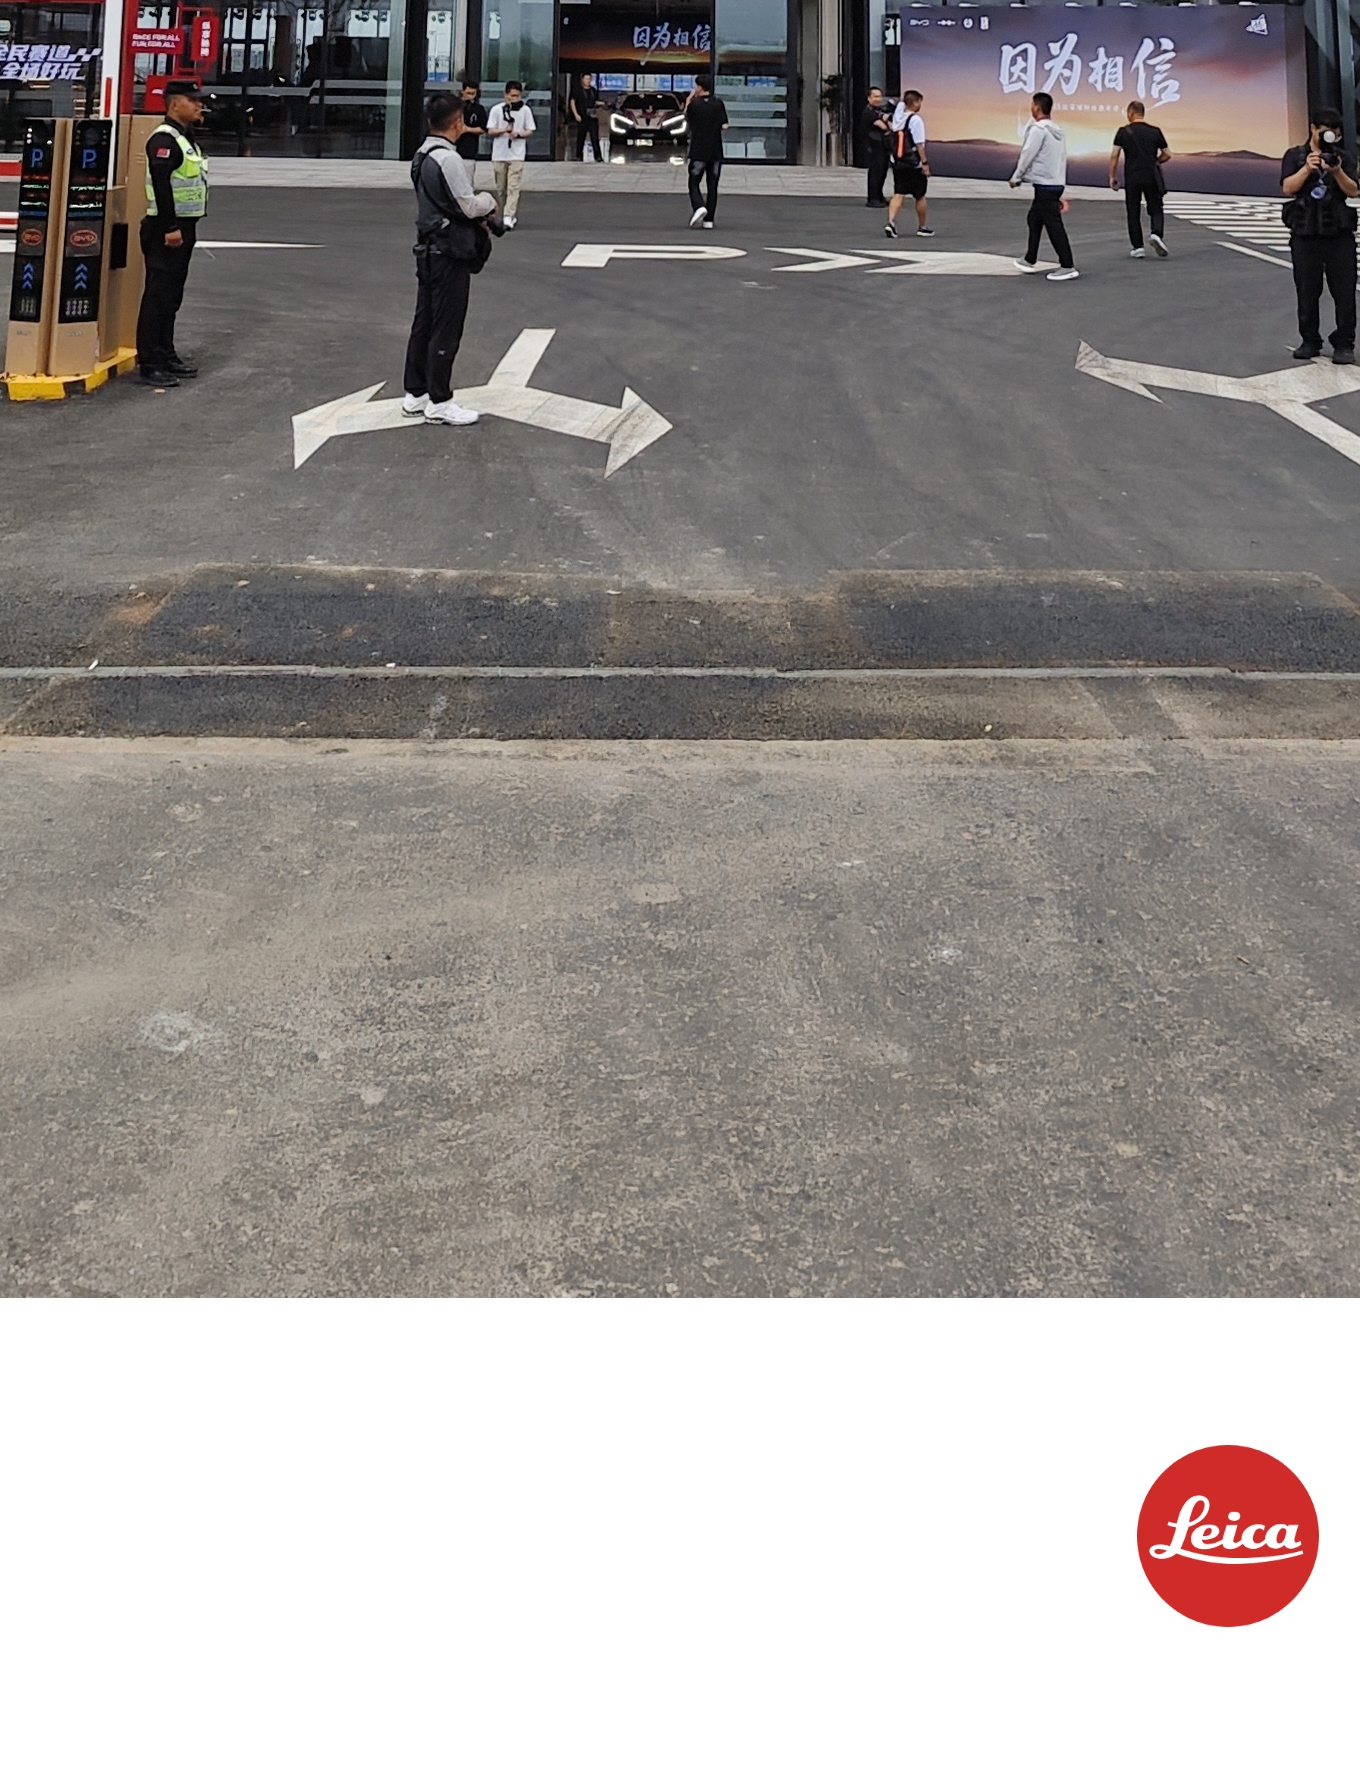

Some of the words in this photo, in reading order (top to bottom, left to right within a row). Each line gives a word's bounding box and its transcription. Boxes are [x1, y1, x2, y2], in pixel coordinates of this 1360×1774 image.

[633, 22, 711, 52] 因为相信
[998, 32, 1181, 105] 因为相信
[31, 148, 44, 168] P
[82, 148, 97, 169] P
